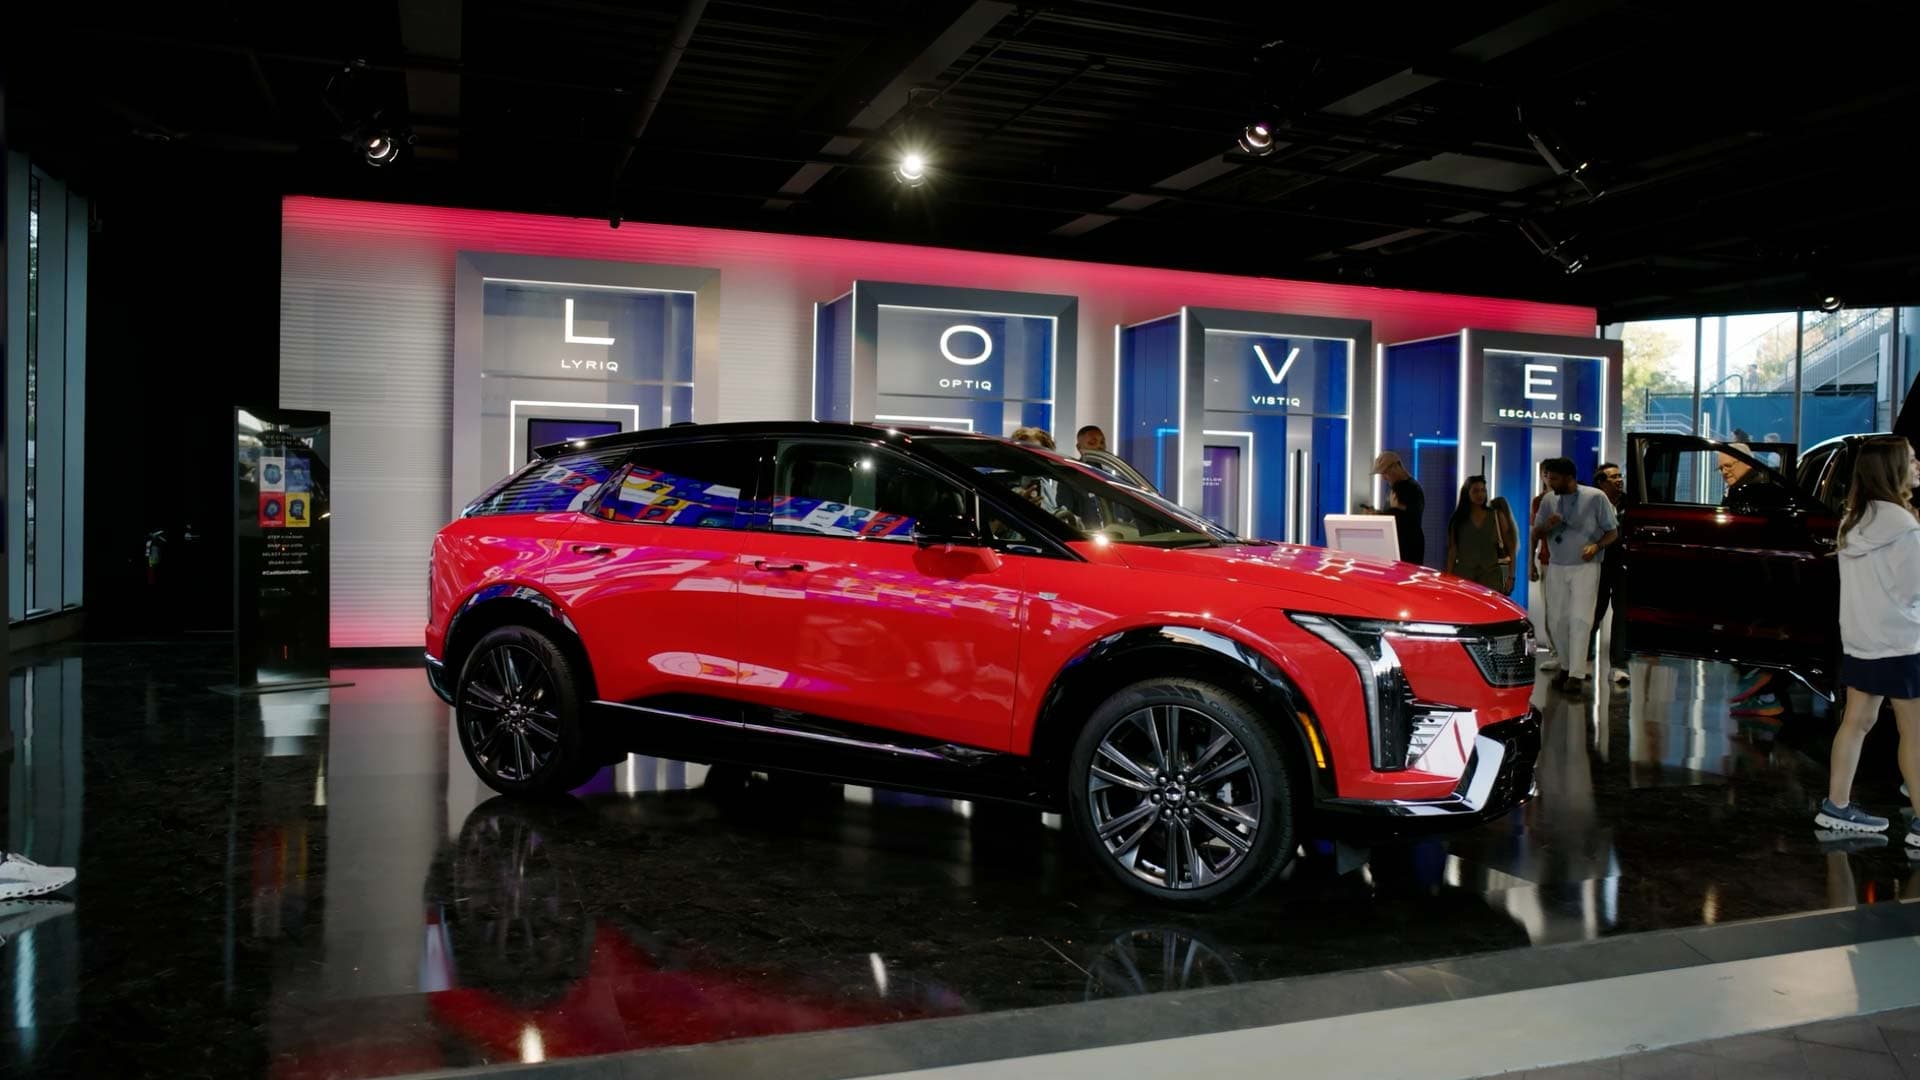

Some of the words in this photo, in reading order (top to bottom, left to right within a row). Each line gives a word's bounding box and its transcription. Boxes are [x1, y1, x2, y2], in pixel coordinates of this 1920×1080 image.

[564, 298, 616, 345] L
[939, 324, 993, 366] O
[560, 358, 619, 373] LYRIQ
[1253, 344, 1300, 384] V
[938, 377, 993, 392] OPTIQ
[1524, 363, 1558, 401] E
[1251, 395, 1301, 409] VISTIQ
[1499, 408, 1565, 421] ESCALADE
[1569, 412, 1582, 423] IQ
